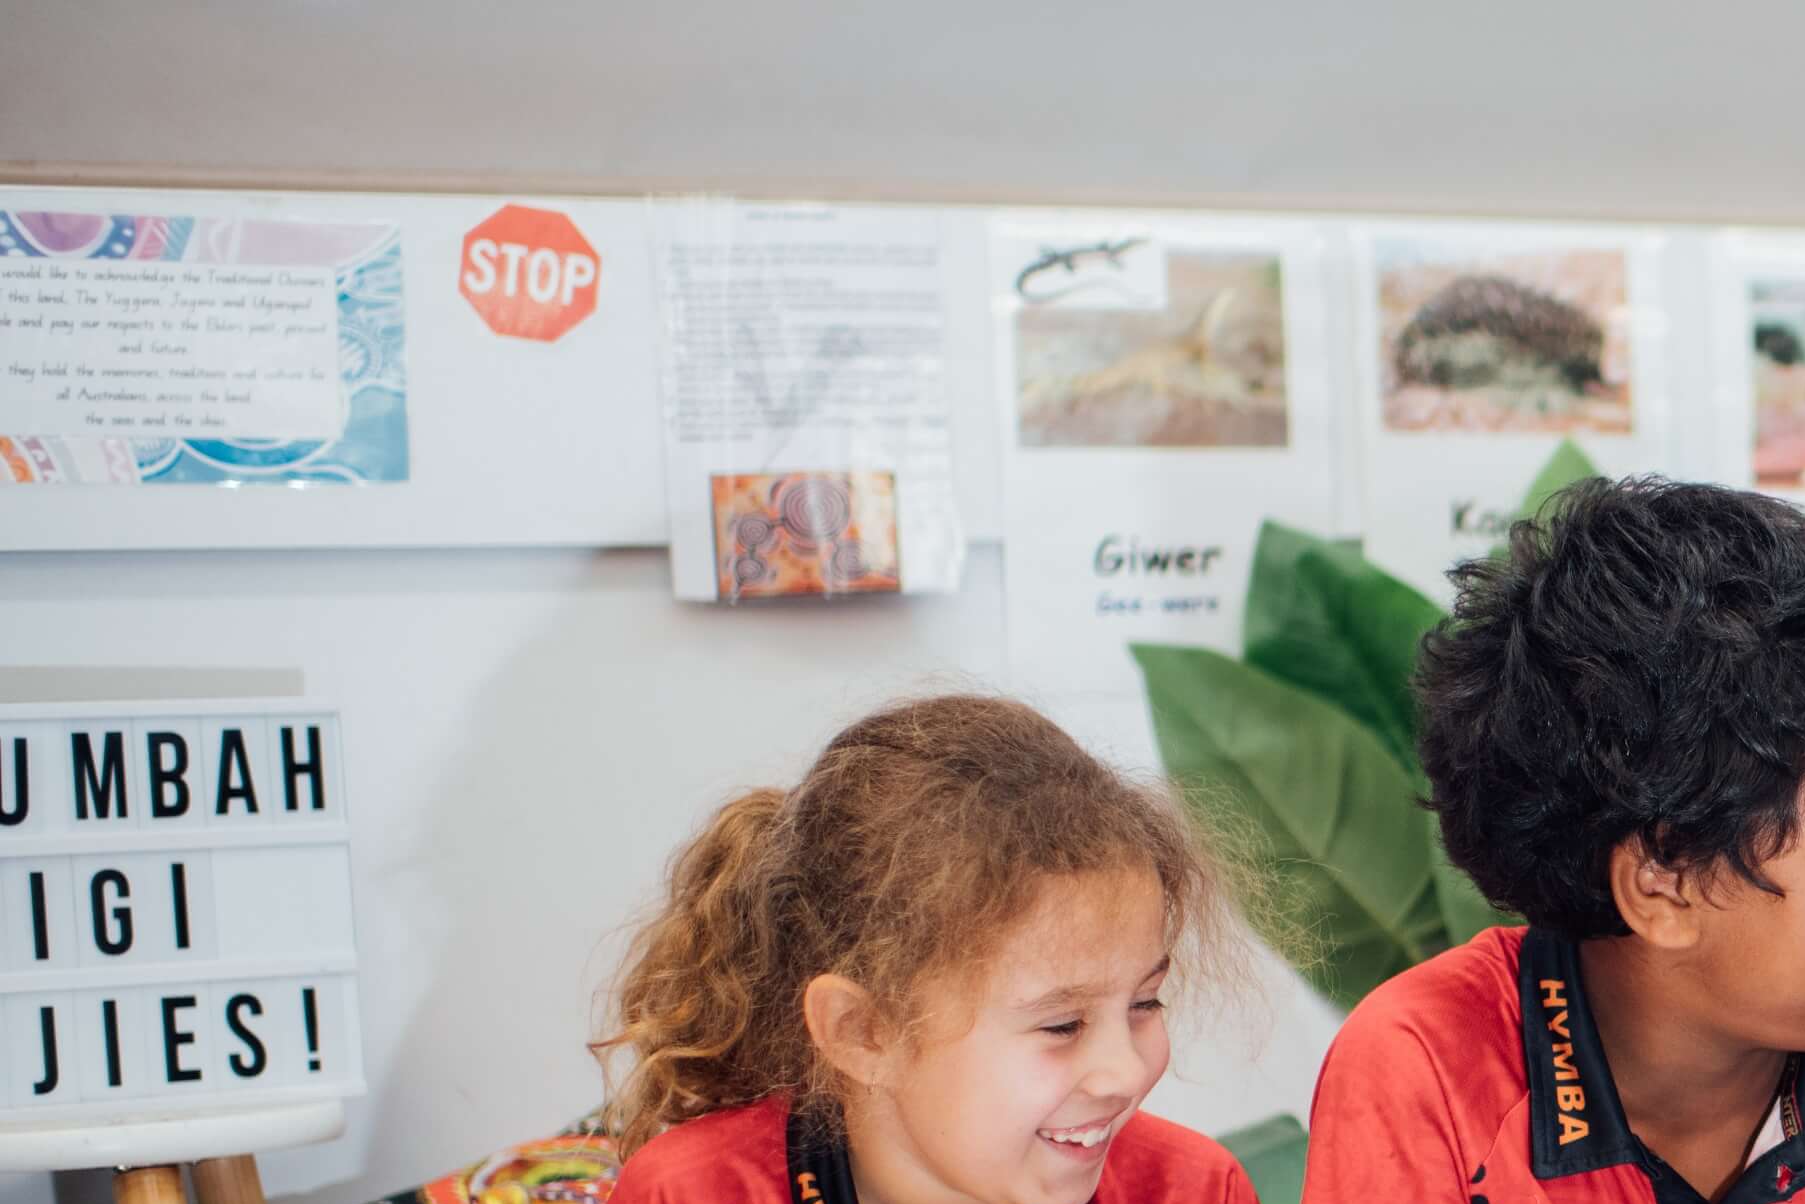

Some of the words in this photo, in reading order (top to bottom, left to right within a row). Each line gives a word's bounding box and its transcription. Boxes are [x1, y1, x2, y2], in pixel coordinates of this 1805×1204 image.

[461, 237, 597, 307] STOP
[1091, 533, 1223, 579] Giwer
[29, 862, 191, 962] IGI
[33, 986, 322, 1095] JIES!
[1539, 979, 1589, 1146] HYMBA
